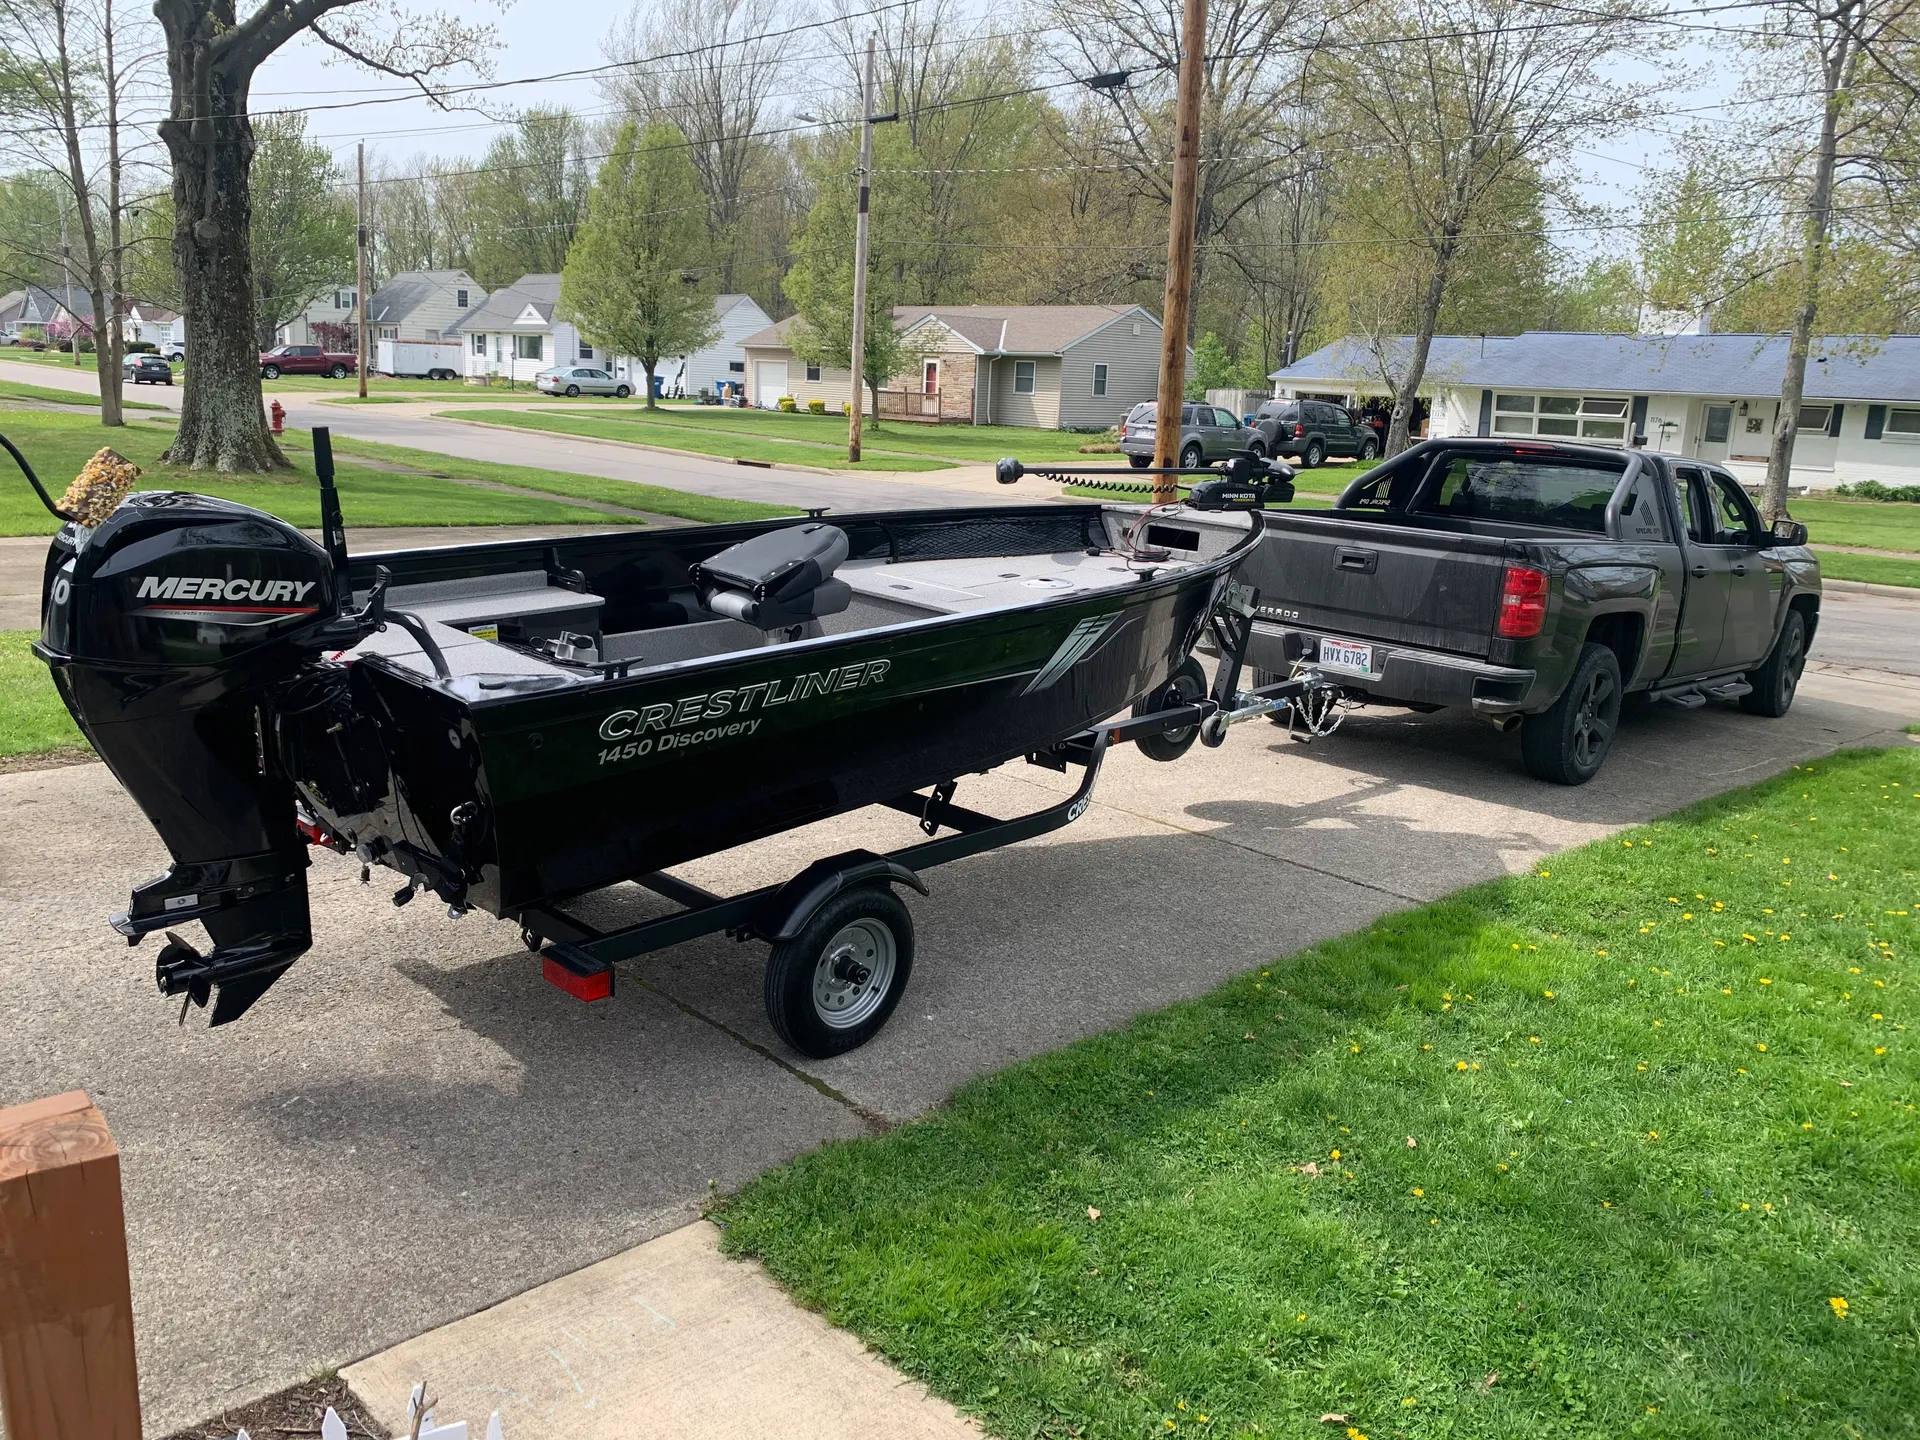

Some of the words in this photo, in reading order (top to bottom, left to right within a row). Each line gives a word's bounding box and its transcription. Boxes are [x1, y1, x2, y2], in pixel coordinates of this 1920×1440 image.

[136, 576, 316, 602] MERCURY
[1323, 646, 1342, 662] HVX
[1343, 649, 1368, 667] 6782
[599, 659, 891, 741] CRESTLINER
[598, 739, 652, 765] 1450
[657, 718, 762, 751] Discovery
